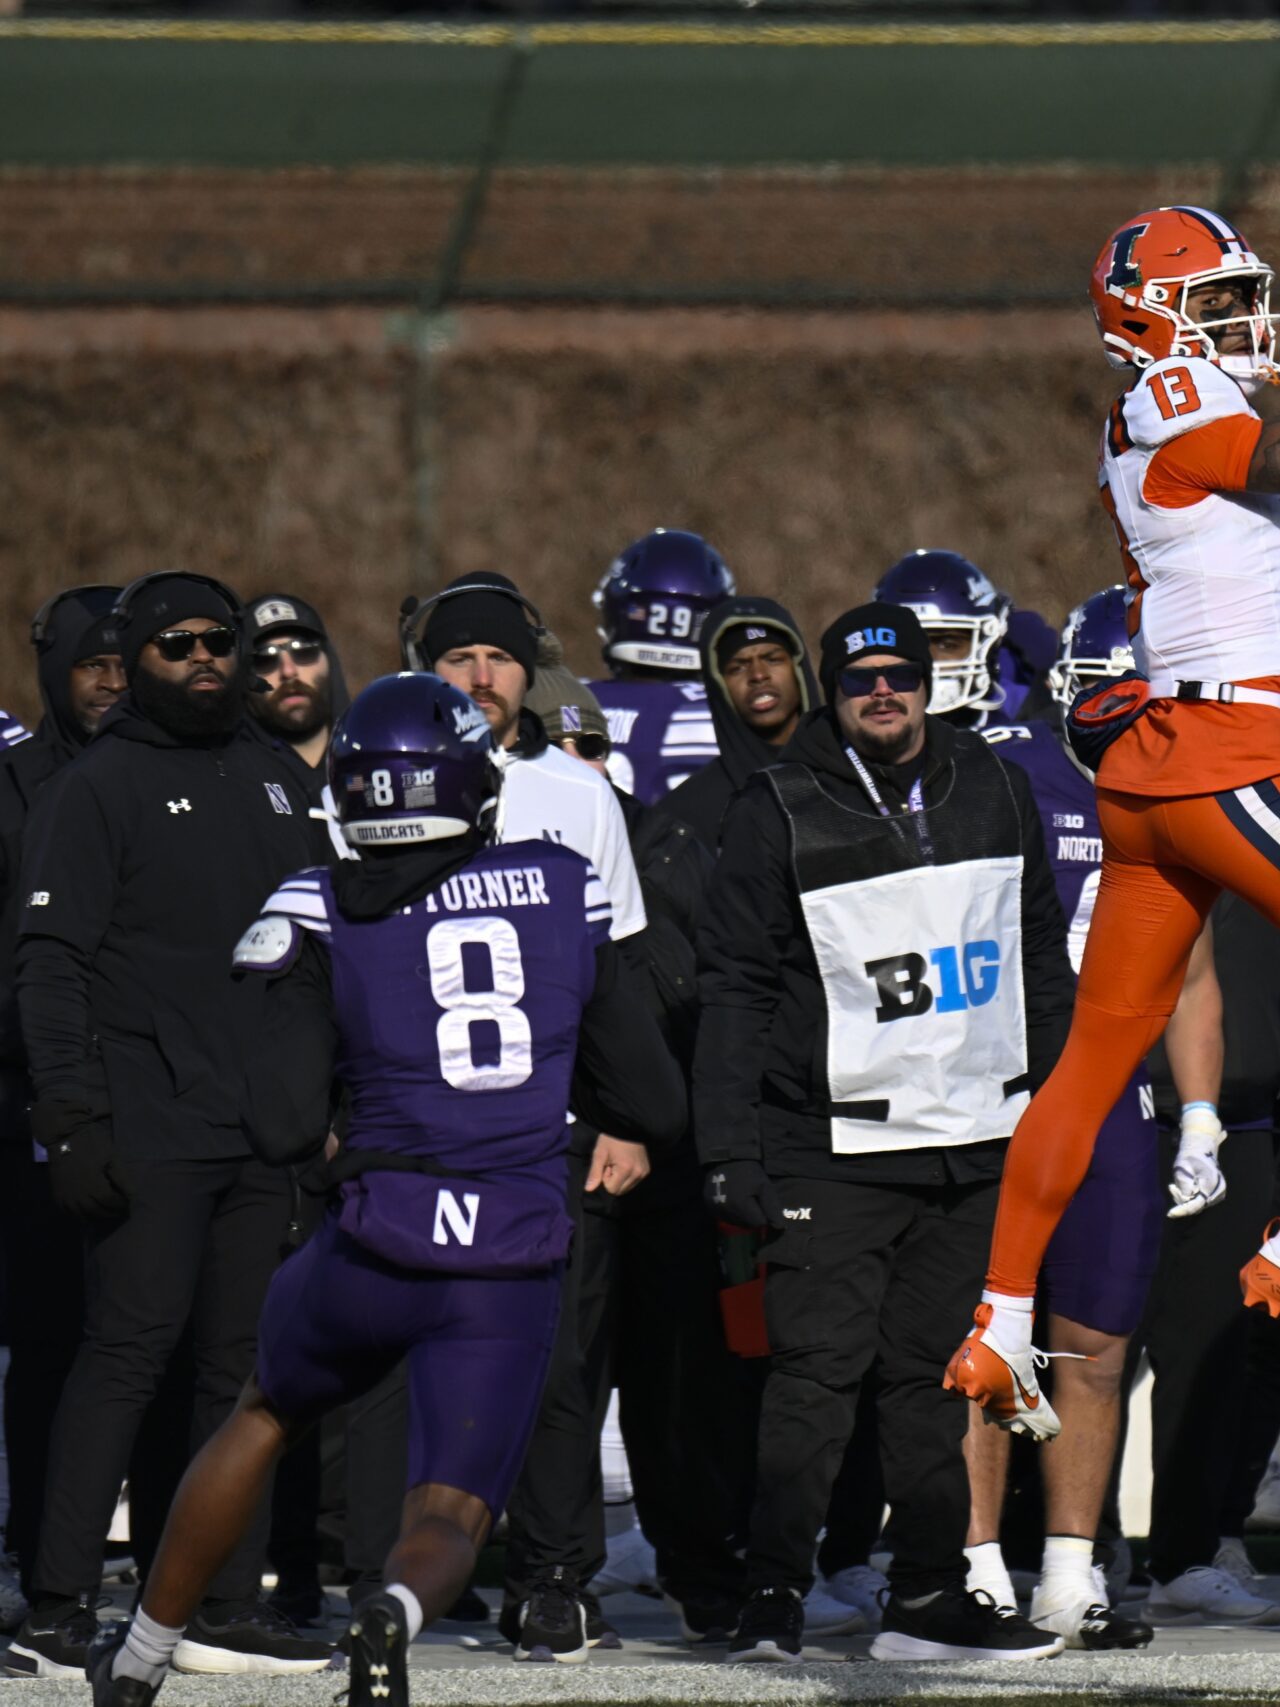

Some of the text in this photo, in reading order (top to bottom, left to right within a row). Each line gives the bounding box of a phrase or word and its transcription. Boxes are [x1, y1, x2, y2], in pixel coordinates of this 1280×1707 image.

[1146, 366, 1202, 420] 13
[648, 603, 691, 637] 29
[560, 705, 582, 732] N
[263, 782, 293, 815] N
[372, 769, 394, 806] 8
[357, 824, 425, 842] WILDCATS
[427, 916, 533, 1091] 8
[1138, 1084, 1155, 1120] N
[433, 1188, 480, 1247] N
